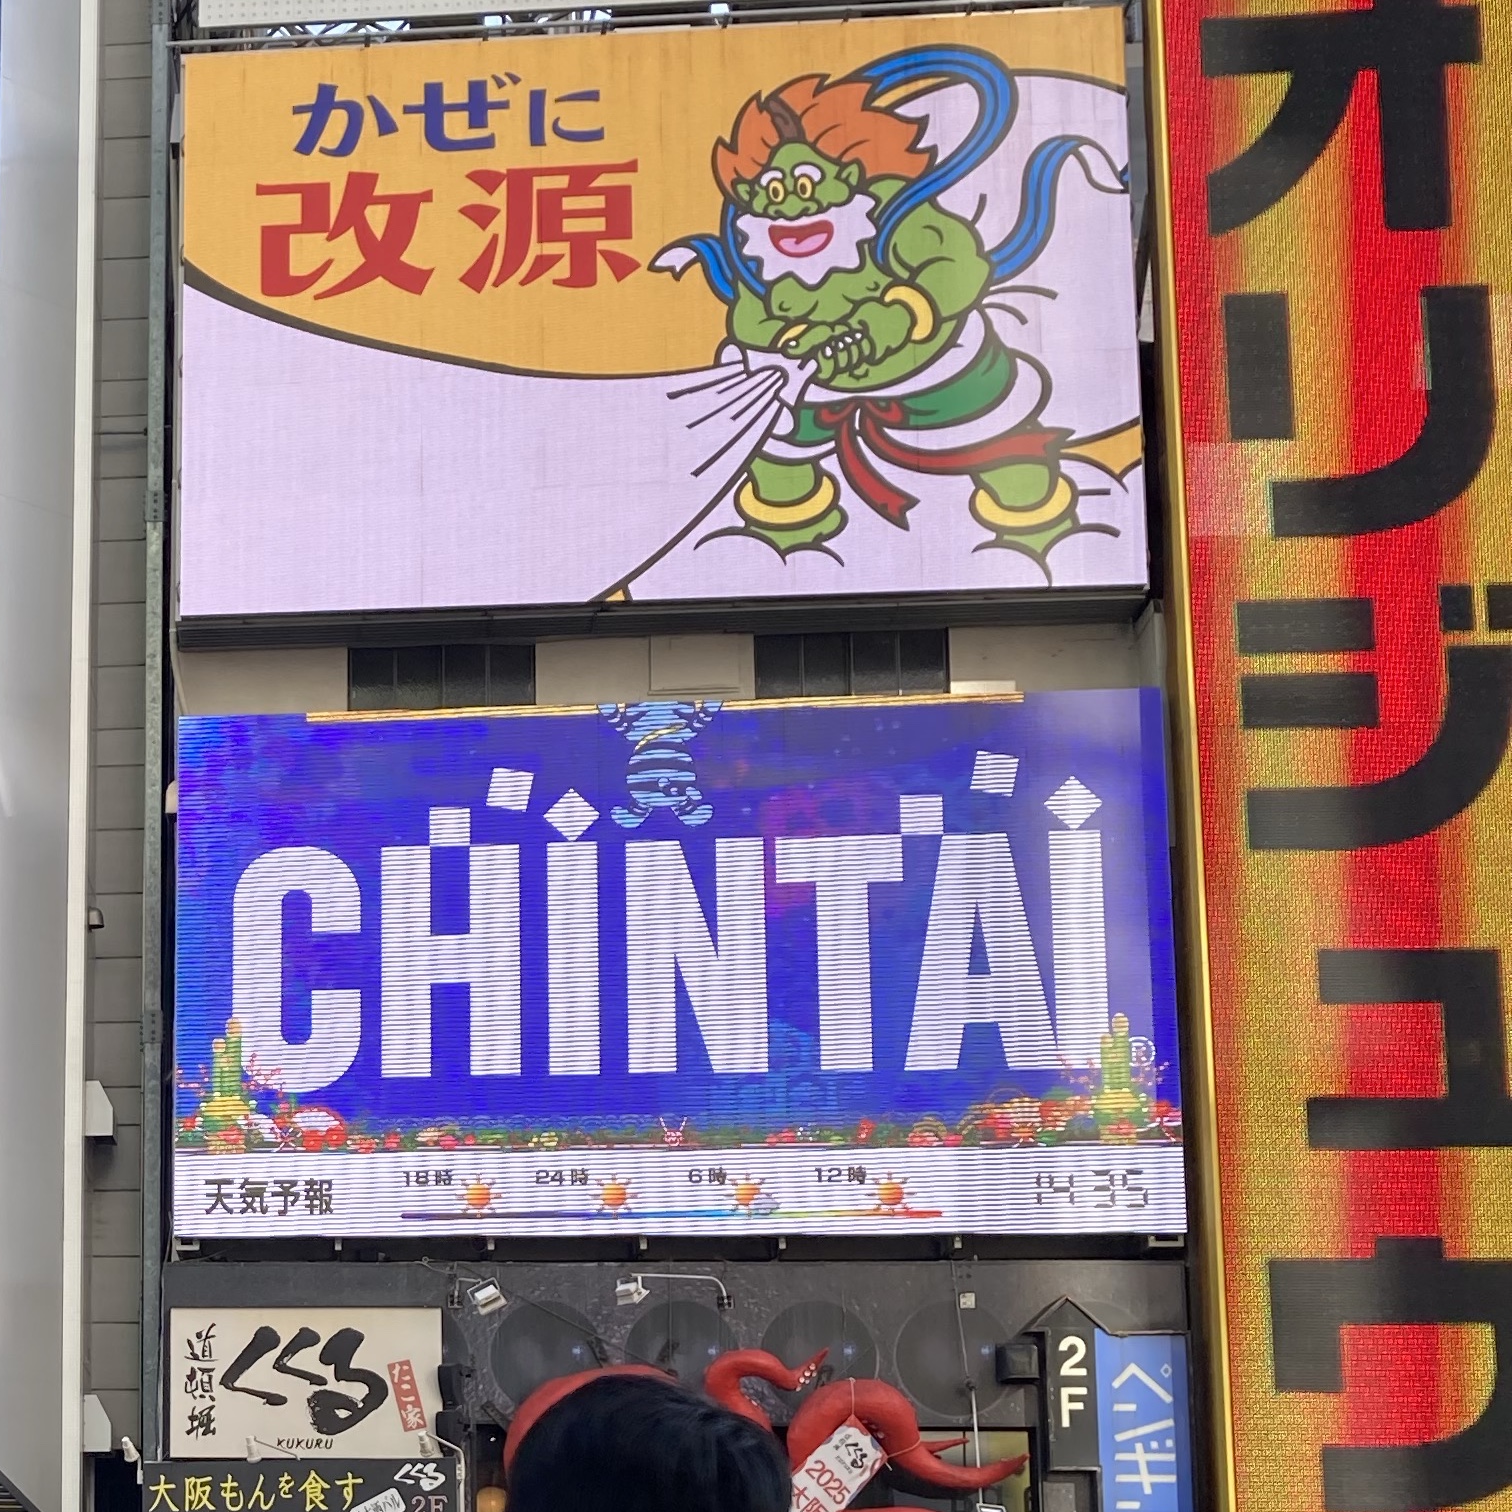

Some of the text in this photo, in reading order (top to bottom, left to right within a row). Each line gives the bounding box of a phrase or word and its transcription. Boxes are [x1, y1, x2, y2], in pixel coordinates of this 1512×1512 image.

[292, 72, 606, 158] かぜに
[255, 159, 652, 301] 改源
[203, 1177, 334, 1216] 天気予報
[184, 1322, 219, 1441] 道頓堀
[219, 1324, 389, 1436] くくる
[392, 1363, 426, 1431] たこ家
[276, 1437, 335, 1451] KUKURU
[393, 1462, 446, 1492] くくる
[805, 1459, 851, 1505] 2025
